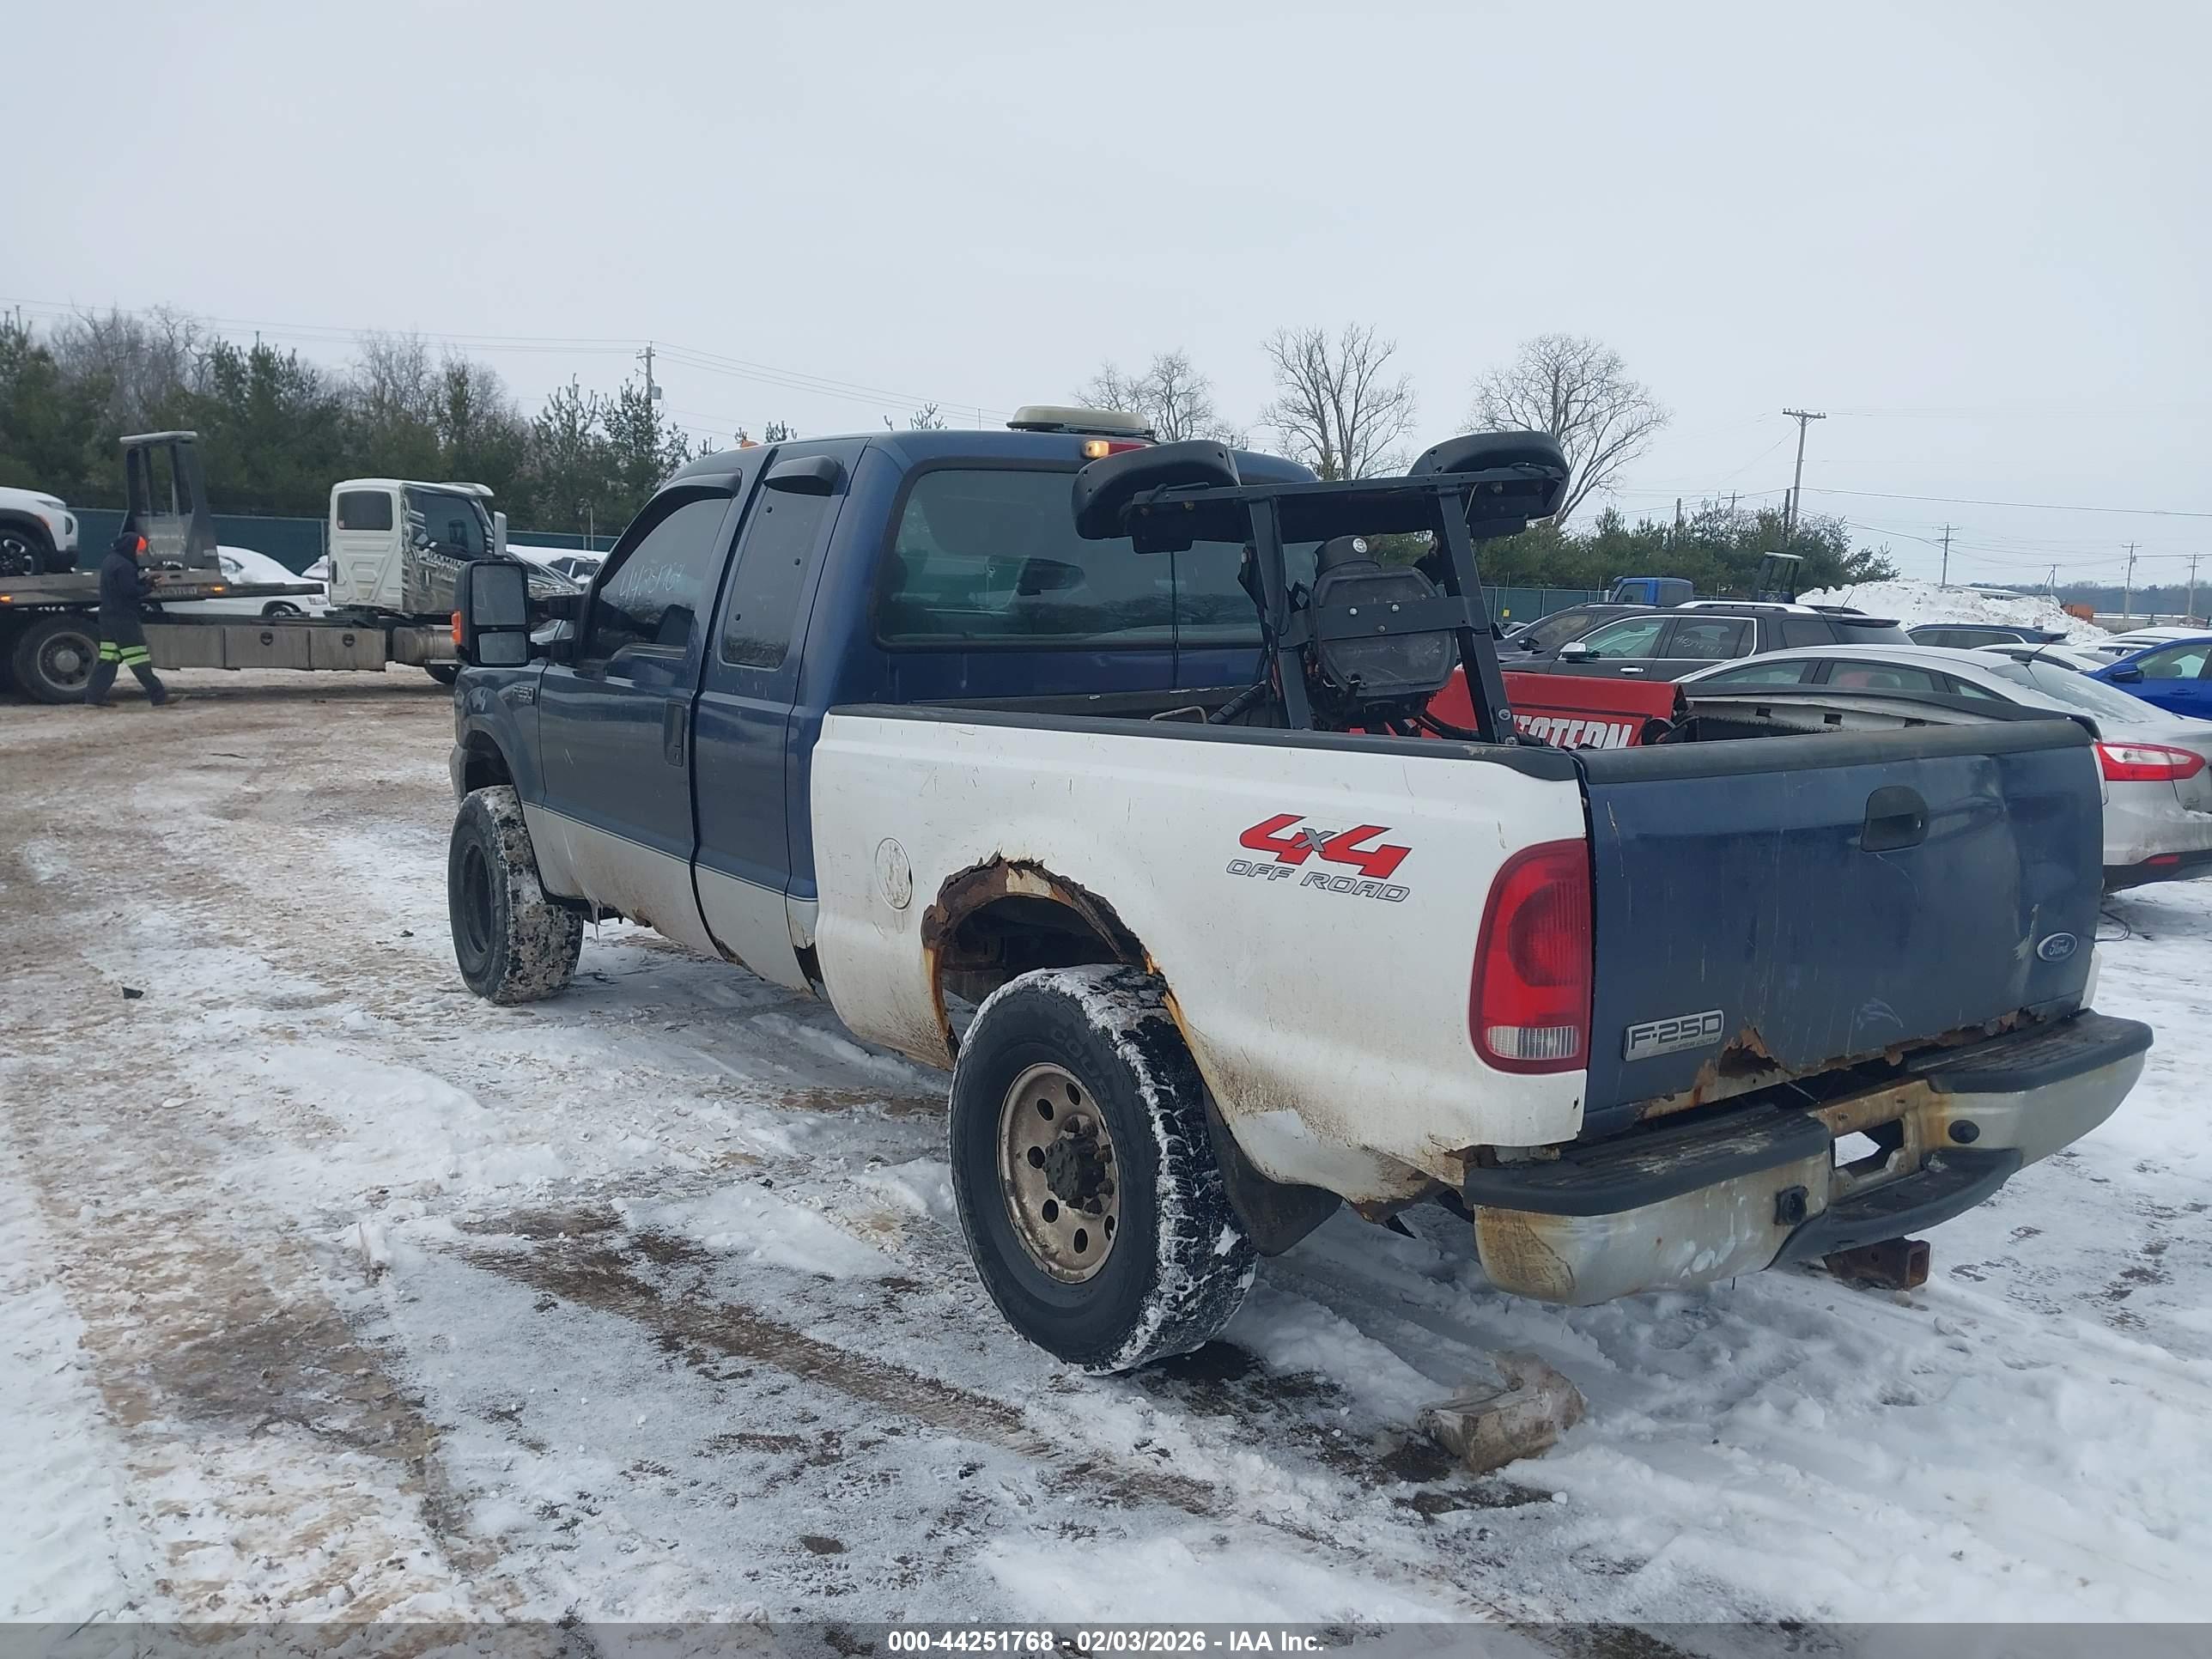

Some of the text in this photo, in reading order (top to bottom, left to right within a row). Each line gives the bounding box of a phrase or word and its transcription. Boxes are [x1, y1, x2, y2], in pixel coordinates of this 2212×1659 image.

[1225, 859, 1411, 902] OFF ROAD
[1631, 1013, 1723, 1050] F-250
